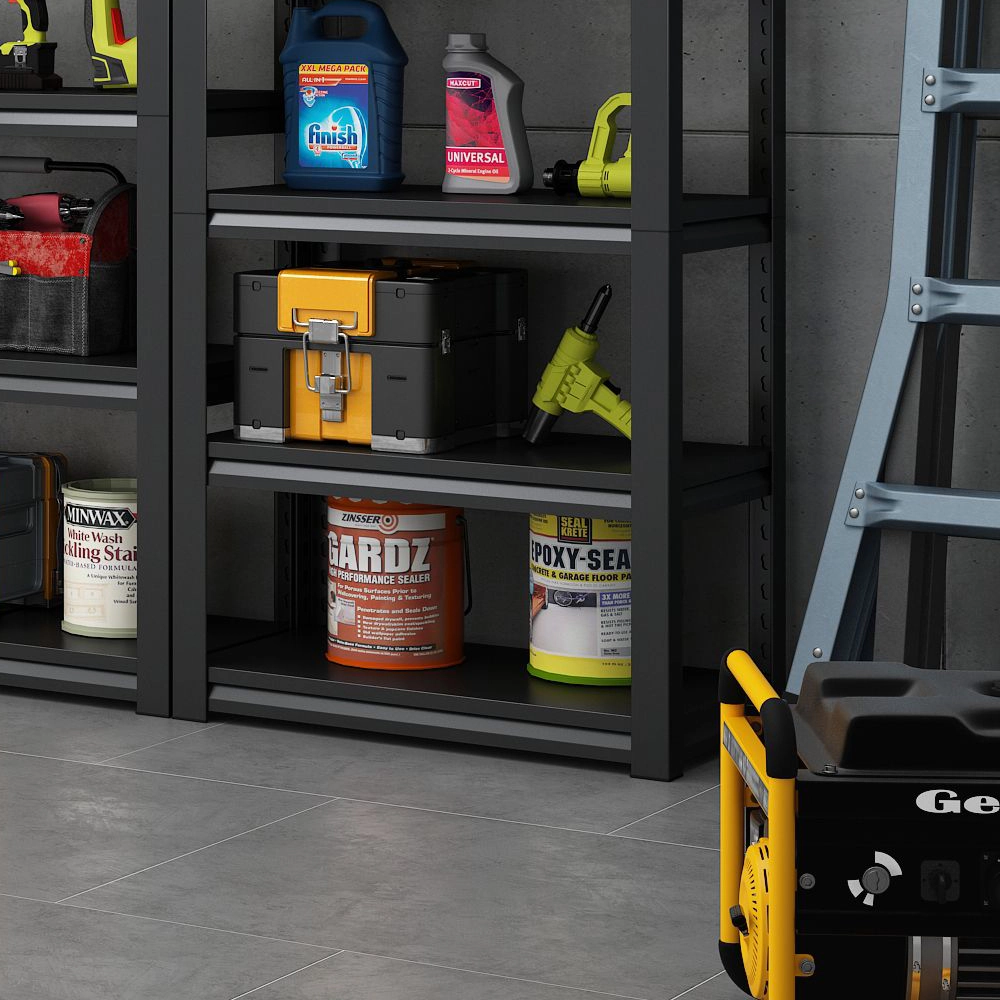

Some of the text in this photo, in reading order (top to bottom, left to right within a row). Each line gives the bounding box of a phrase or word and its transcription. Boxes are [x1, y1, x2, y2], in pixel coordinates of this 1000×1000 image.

[301, 64, 316, 72] XXL
[318, 64, 342, 72] MEGA
[308, 123, 358, 145] finish
[447, 151, 505, 163] UNIVERSAL
[67, 505, 127, 526] MINWAX
[342, 513, 380, 524] ZINSSER
[561, 516, 587, 527] SEAL
[67, 527, 123, 544] White Wash
[561, 527, 588, 537] KRETE
[328, 530, 431, 573] GARDZ
[98, 564, 137, 572] FORMULA
[337, 571, 395, 584] PERFORMANCE
[398, 573, 431, 584] SEALER
[558, 572, 590, 581] GARAGE
[592, 573, 618, 581] FLOOR
[344, 584, 362, 592] Porous
[357, 606, 389, 614] Penetrates
[916, 789, 1000, 814] Ge
